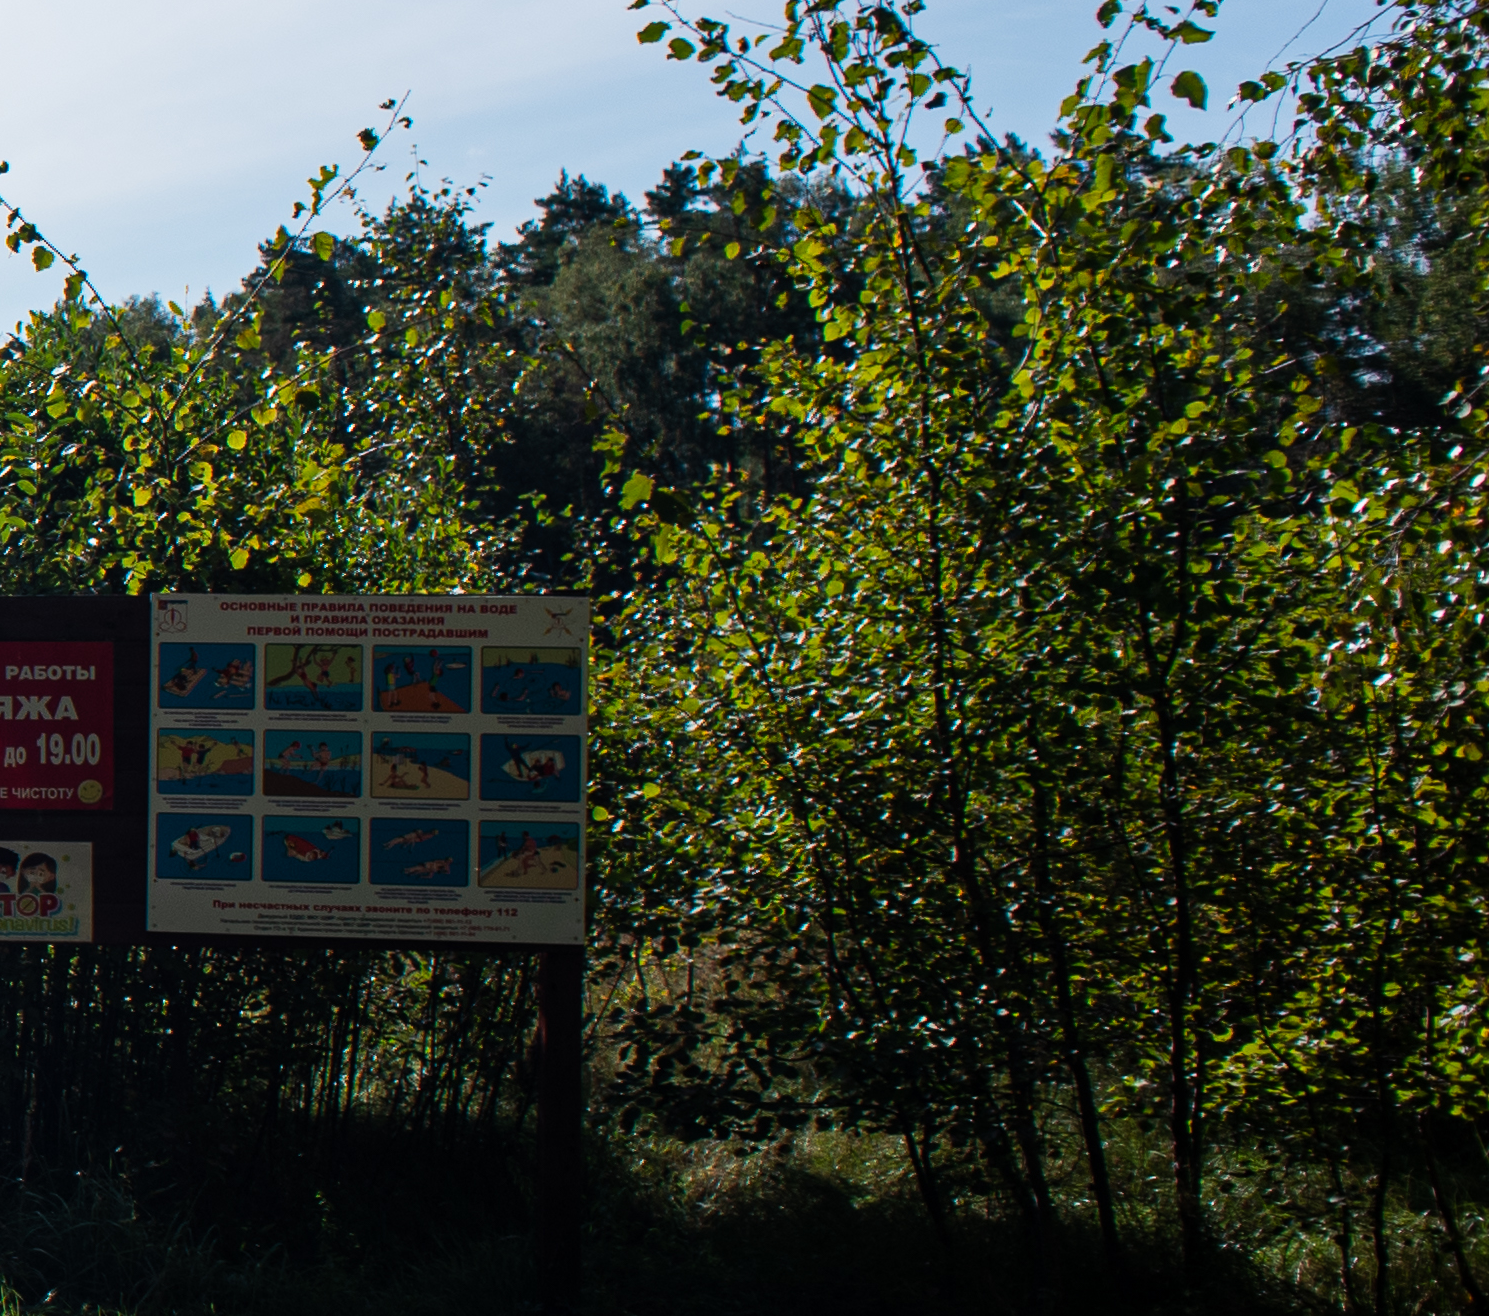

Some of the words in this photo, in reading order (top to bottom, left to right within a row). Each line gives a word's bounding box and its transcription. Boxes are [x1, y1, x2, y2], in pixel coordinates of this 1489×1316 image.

[220, 601, 298, 613] ОСНОВНЫЕ
[301, 602, 366, 614] ПРАВИЛА
[369, 603, 452, 615] ПОВЕДЕНИЯ
[456, 603, 477, 614] НА
[480, 603, 518, 616] ВОДЕ
[290, 615, 300, 625] И
[303, 615, 368, 626] ПРАВИЛА
[371, 615, 445, 627] ОКАЗАНИЯ
[247, 625, 303, 637] ПЕРВОЙ
[305, 626, 368, 639] ПОМОЩИ
[371, 626, 489, 640] ПОСТРАДАВШИМ
[4, 665, 97, 682] РАБОТЫ
[3, 746, 28, 768] до
[36, 732, 102, 766] 19.00
[11, 786, 75, 801] ЧИСТОТУ
[212, 899, 236, 910] При
[238, 901, 310, 911] несчастных
[313, 904, 361, 914] случаях
[365, 905, 413, 915] звоните
[415, 907, 431, 916] по
[433, 906, 493, 918] телефону
[497, 908, 519, 918] 112
